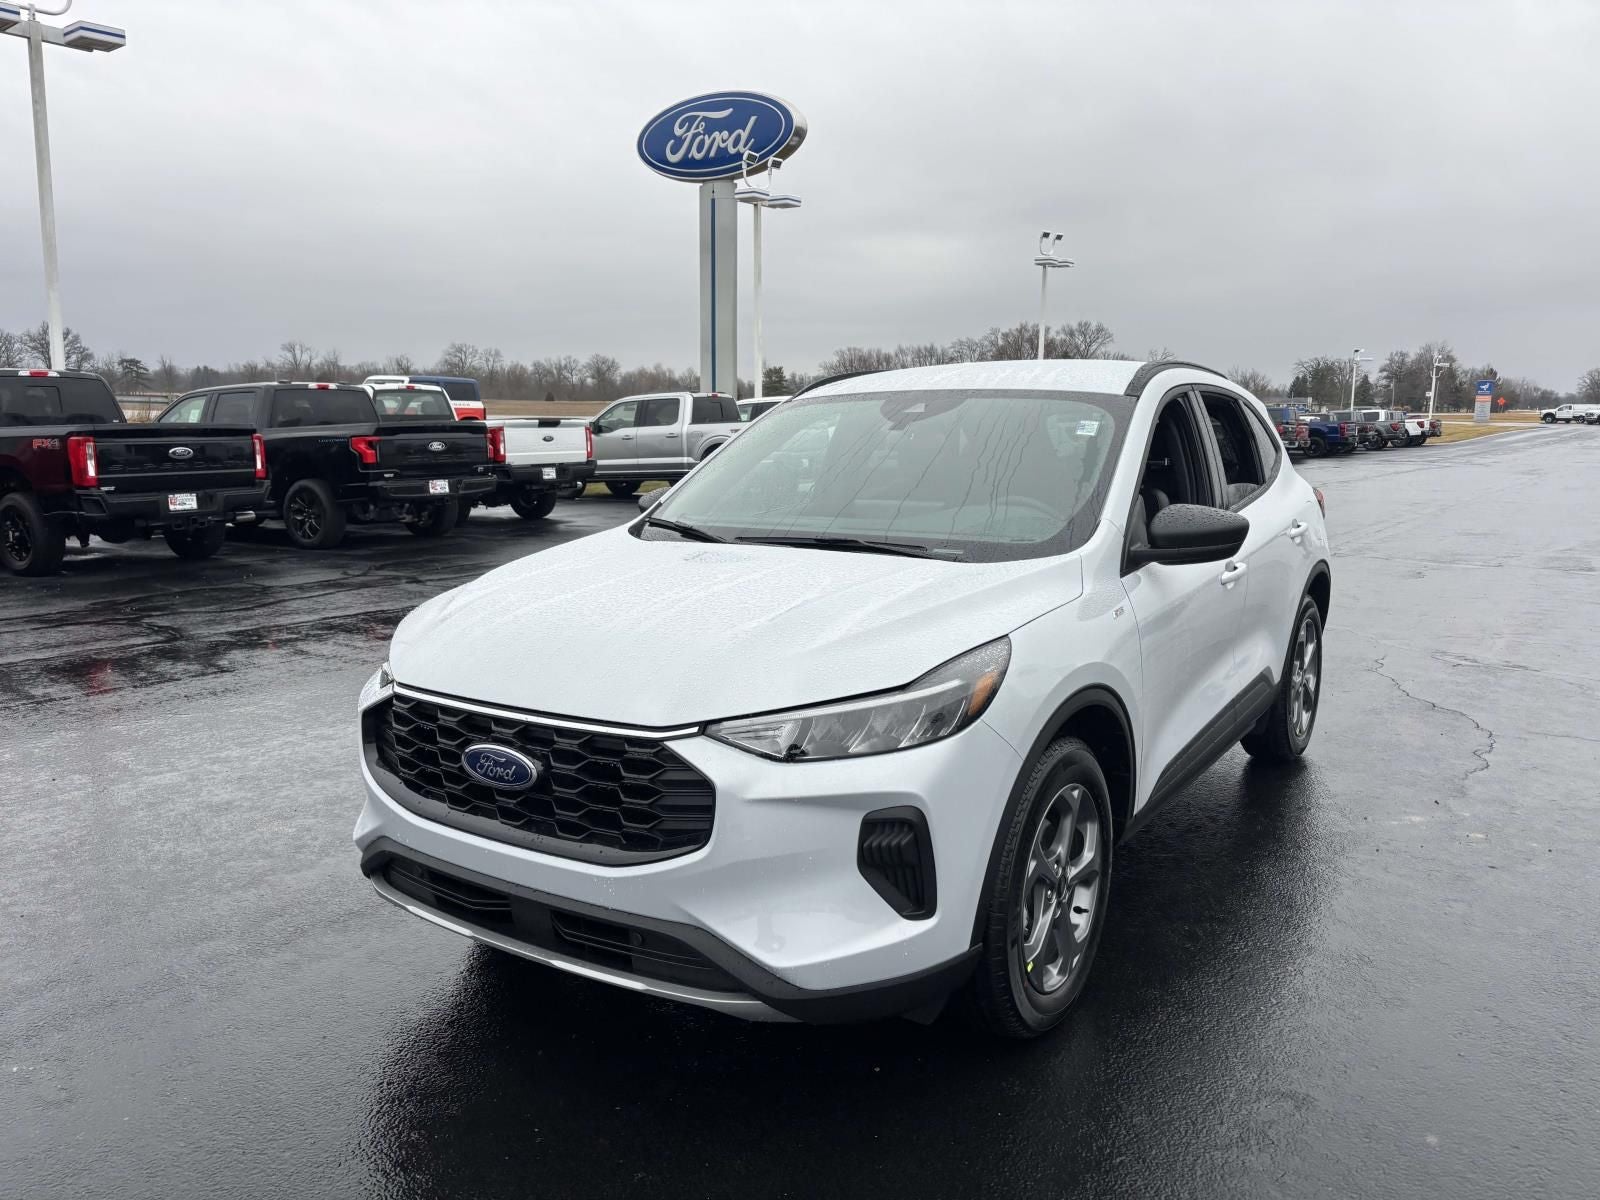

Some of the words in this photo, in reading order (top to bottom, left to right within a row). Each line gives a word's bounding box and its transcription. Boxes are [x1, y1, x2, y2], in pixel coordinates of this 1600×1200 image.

[665, 107, 758, 164] Ford
[32, 438, 60, 449] FX4
[475, 752, 517, 781] Ford
